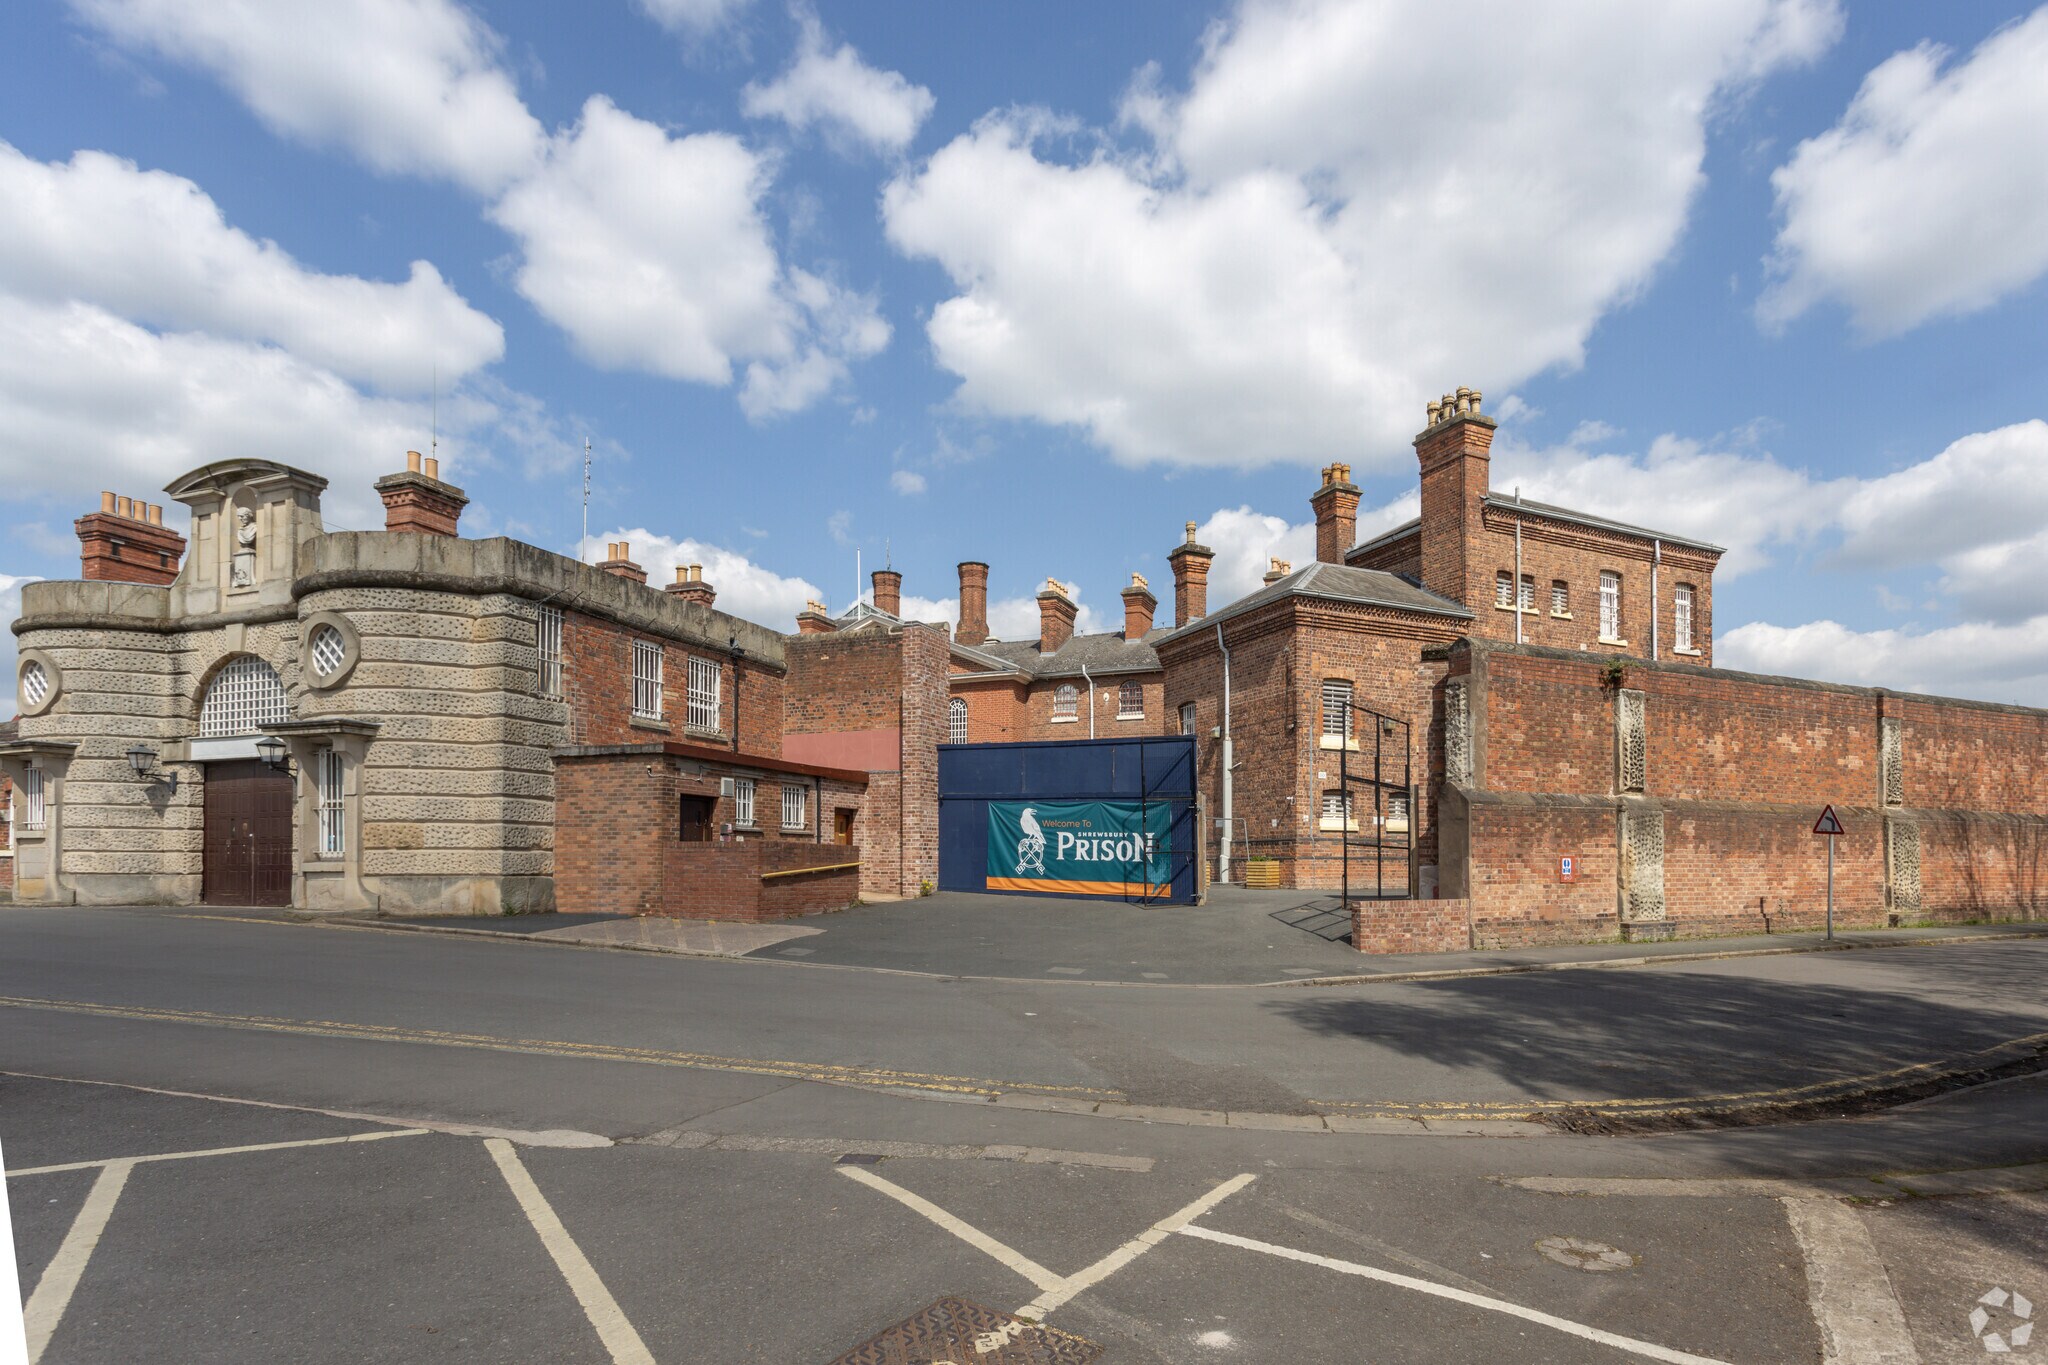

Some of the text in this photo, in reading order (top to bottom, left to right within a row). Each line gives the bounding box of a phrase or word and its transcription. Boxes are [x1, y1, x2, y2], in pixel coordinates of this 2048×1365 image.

[1042, 819, 1092, 828] Welcome To
[1056, 831, 1155, 864] PRISON
